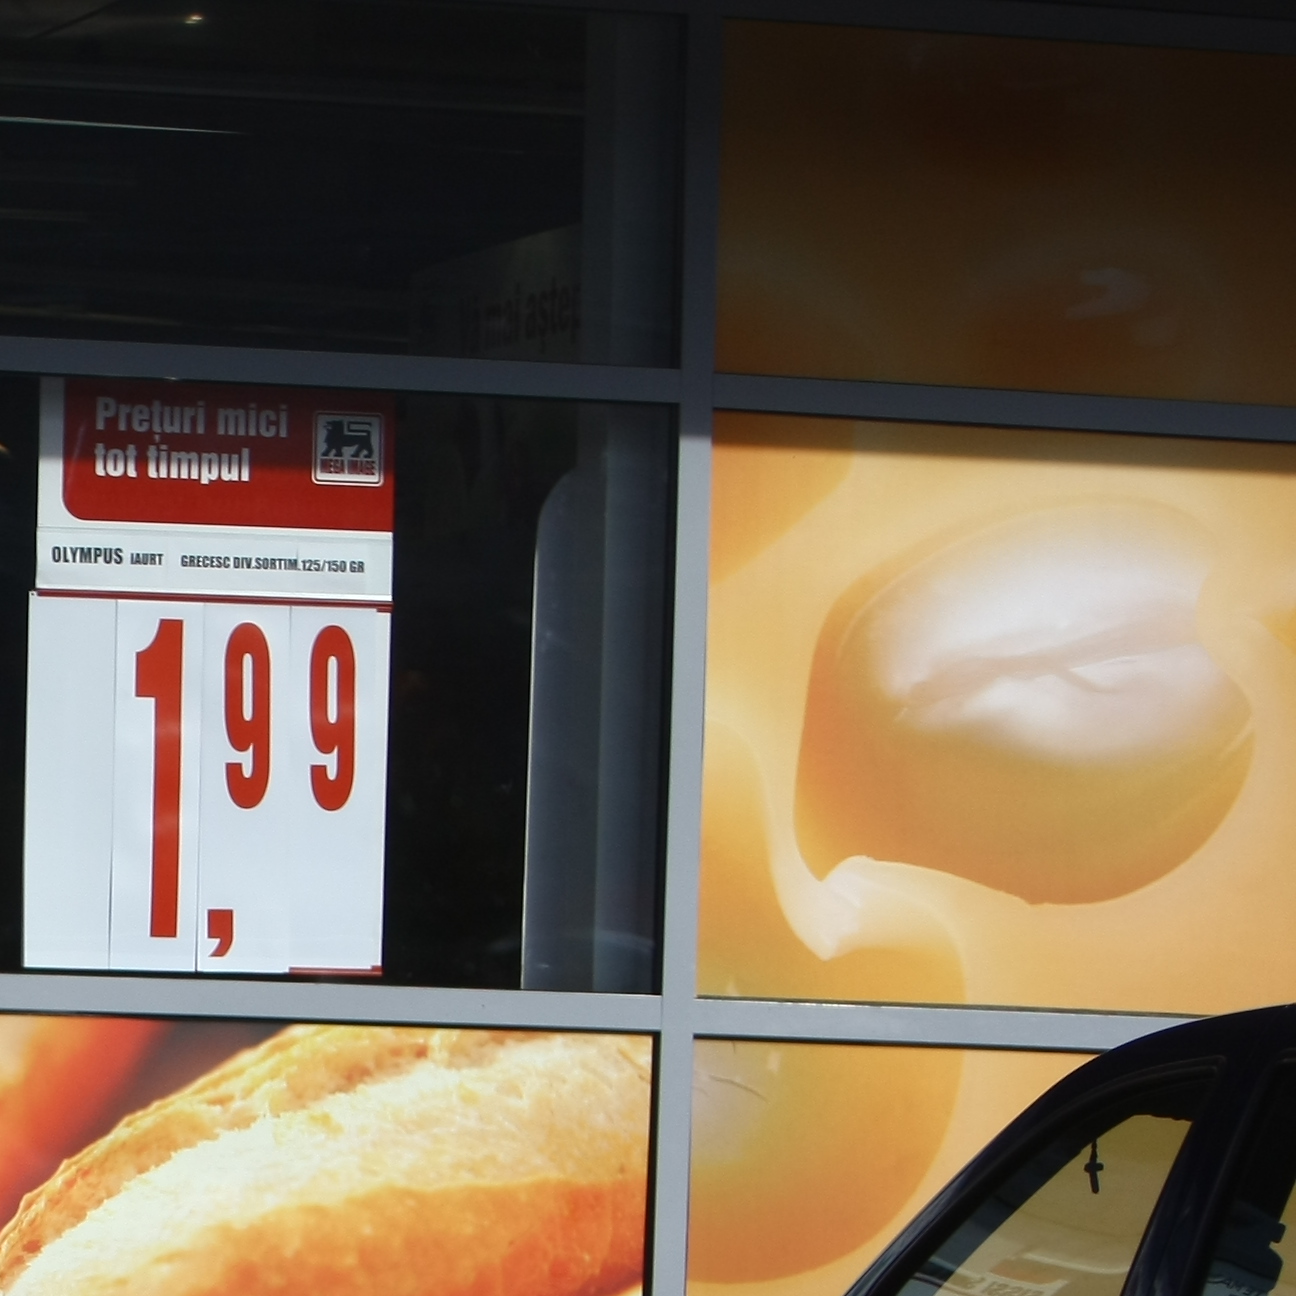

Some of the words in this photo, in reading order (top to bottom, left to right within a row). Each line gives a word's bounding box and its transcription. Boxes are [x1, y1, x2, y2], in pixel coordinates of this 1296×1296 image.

[217, 404, 288, 438] mici
[95, 443, 138, 478] tot
[147, 444, 250, 484] timpul
[51, 546, 123, 565] OLYMPUS
[130, 553, 164, 566] IAURT
[181, 555, 232, 569] GRECESC
[349, 560, 365, 573] GR
